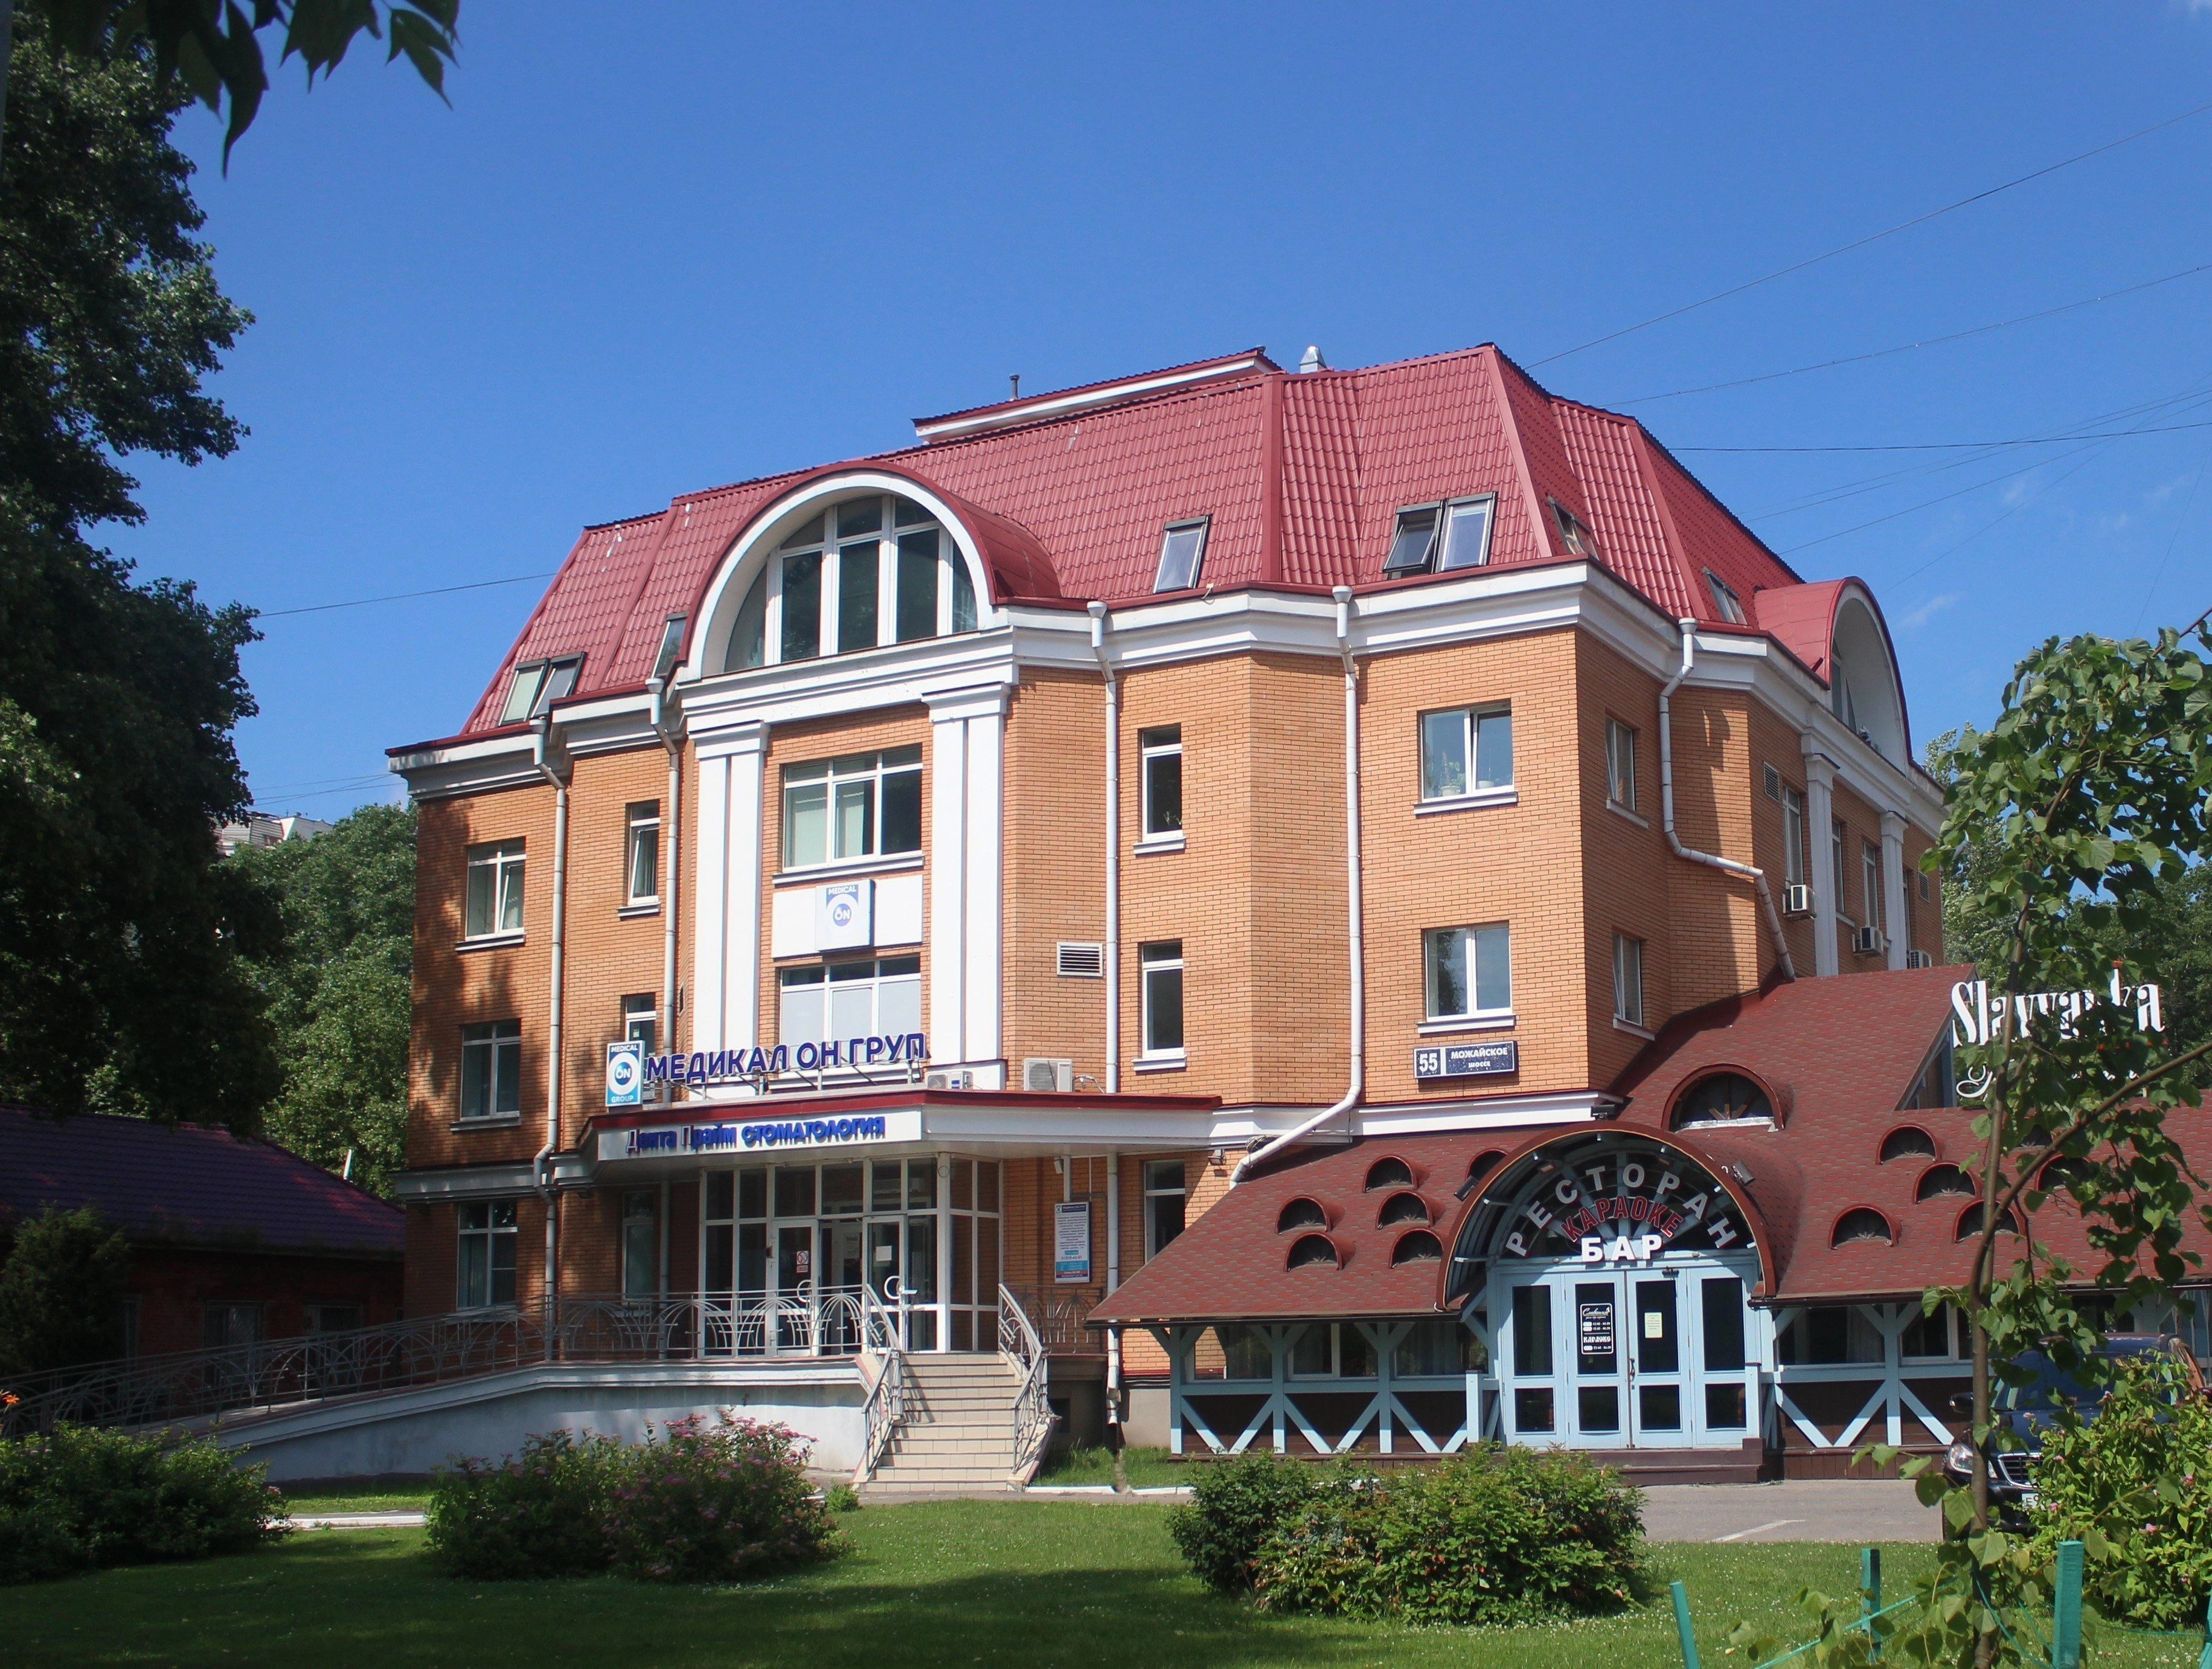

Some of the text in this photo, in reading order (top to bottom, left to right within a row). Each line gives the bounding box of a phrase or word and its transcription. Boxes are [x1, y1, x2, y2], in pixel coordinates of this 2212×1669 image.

[828, 886, 857, 895] MEDICAL
[835, 909, 850, 921] ON
[647, 1032, 927, 1085] МЕДИКАЛ ОН ГРУП
[1419, 1053, 1438, 1072] 55
[1451, 1047, 1508, 1059] МОЖАЙСКОЕ
[616, 1068, 631, 1079] ON
[626, 1116, 886, 1153] Дента Прайм СТОМАТОЛОГИЯ
[1505, 1163, 1739, 1257] РЕСТОРАН
[1560, 1195, 1684, 1242] КАРАОКЕ
[1581, 1235, 1664, 1262] БАР
